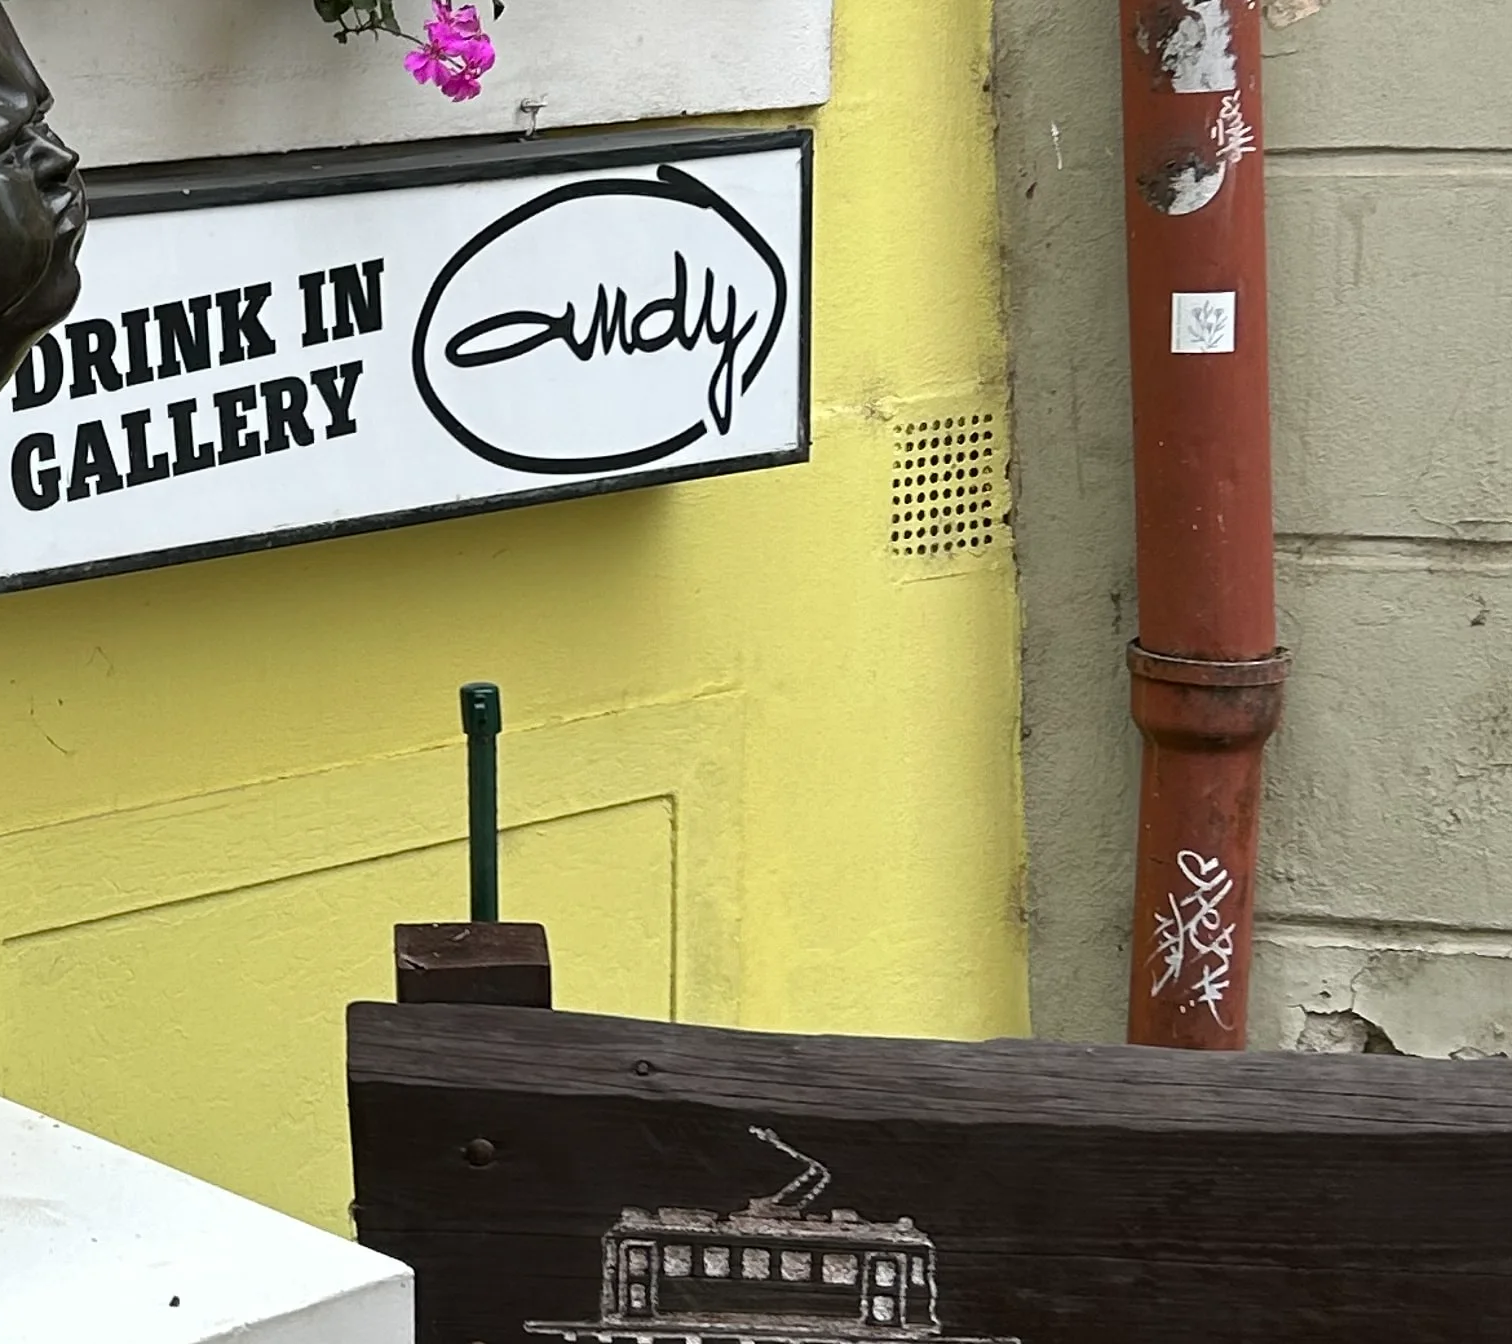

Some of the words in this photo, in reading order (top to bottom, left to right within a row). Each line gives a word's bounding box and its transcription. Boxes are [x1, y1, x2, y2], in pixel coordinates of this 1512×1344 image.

[10, 280, 276, 412] DRINK
[299, 258, 386, 347] IN
[9, 359, 366, 513] GALLERY
